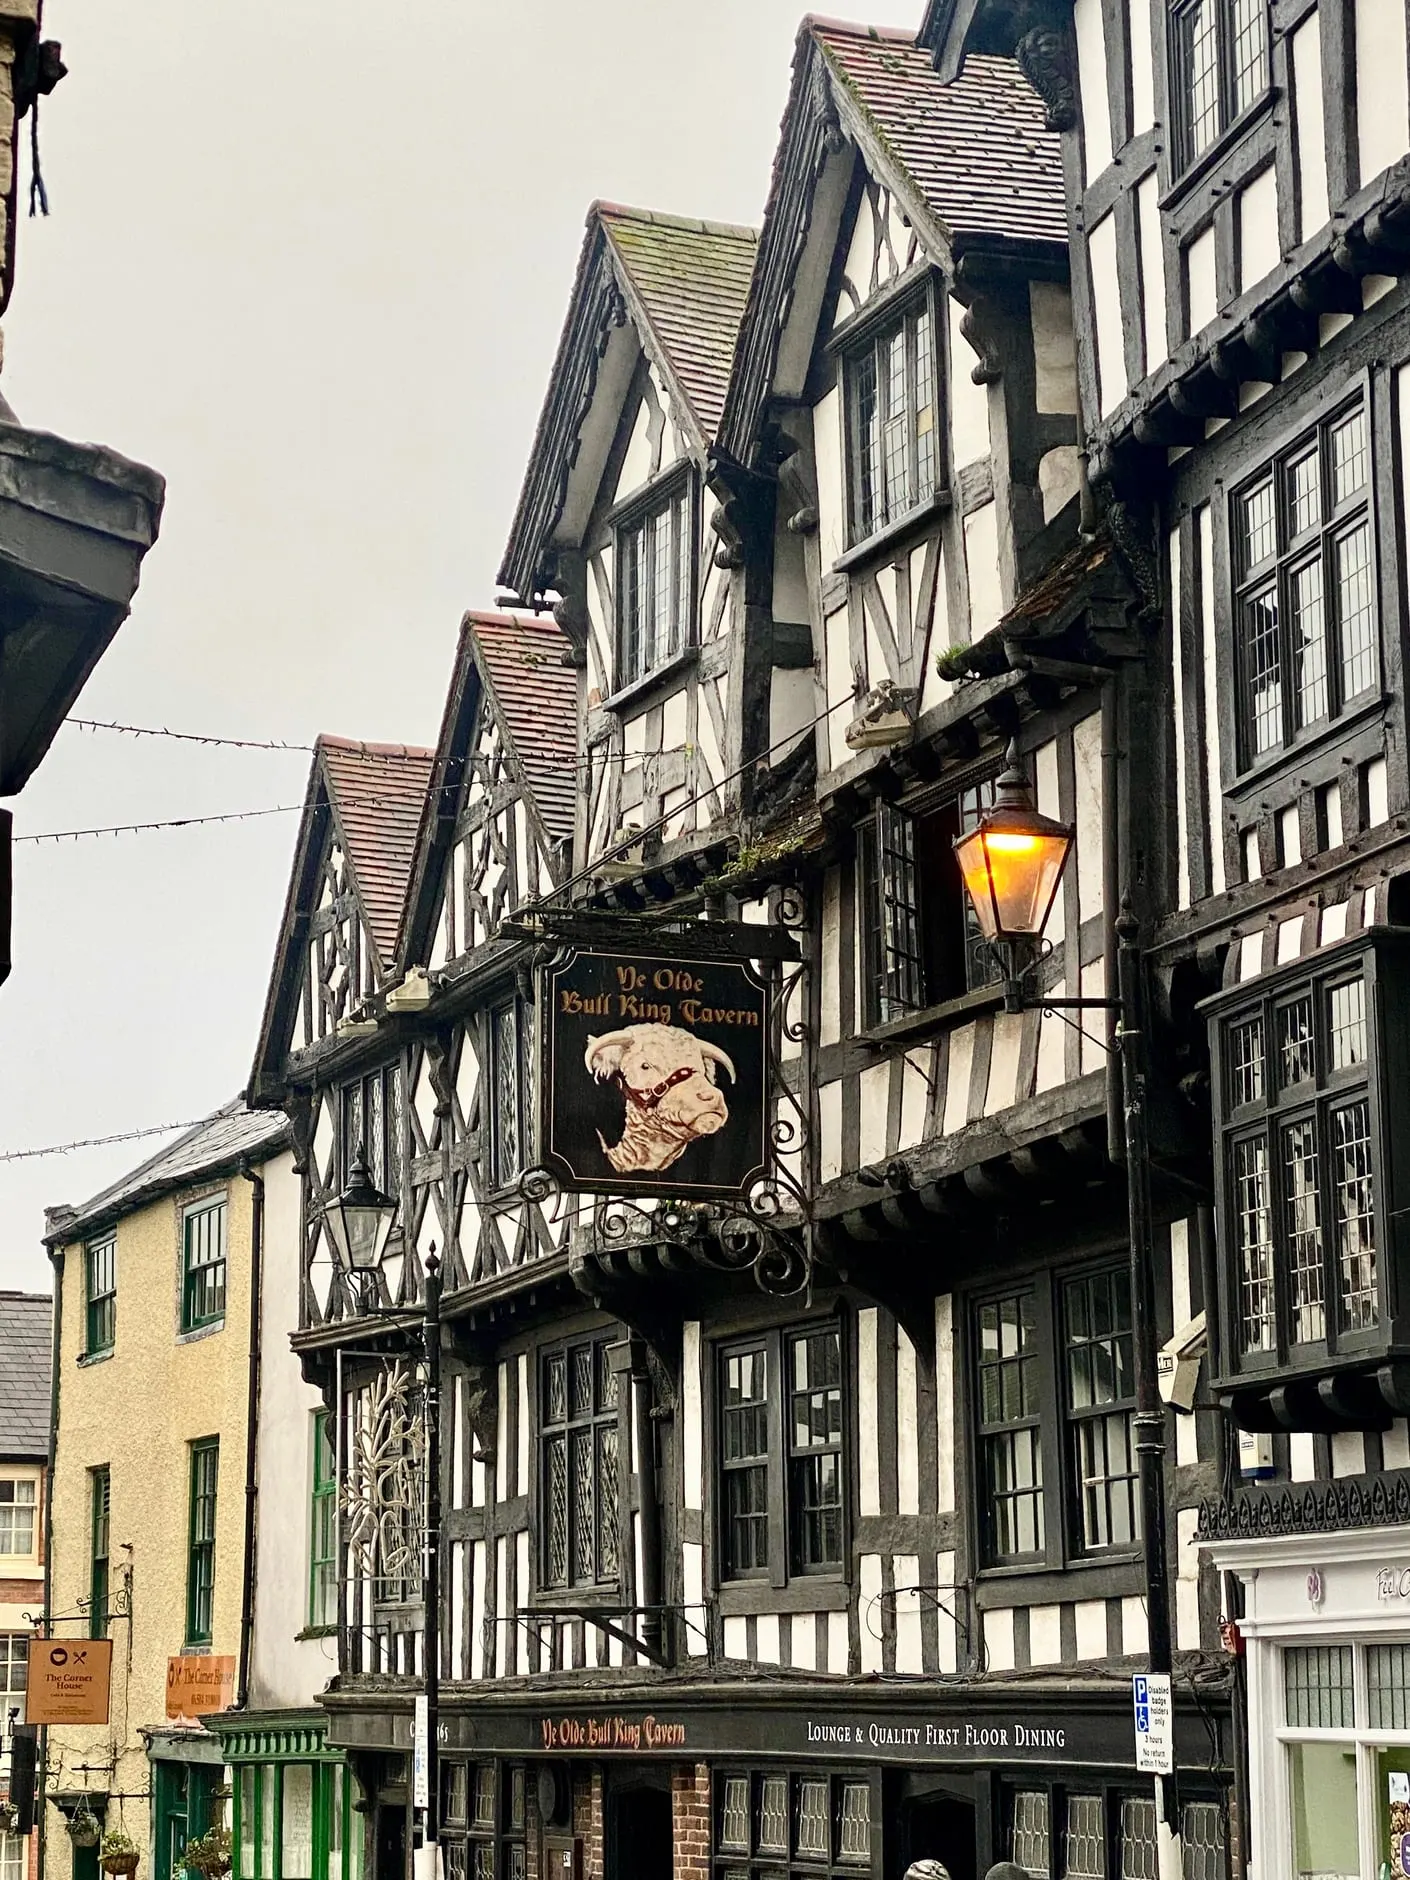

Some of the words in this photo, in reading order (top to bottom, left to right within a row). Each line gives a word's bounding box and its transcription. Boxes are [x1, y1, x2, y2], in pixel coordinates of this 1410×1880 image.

[616, 966, 647, 991] Ye
[653, 968, 704, 992] Olde
[560, 990, 612, 1016] Bull
[618, 994, 671, 1024] Ring
[678, 999, 759, 1026] Tavern
[46, 1674, 62, 1682] The
[63, 1674, 93, 1682] Corner
[56, 1682, 83, 1690] House
[1148, 1686, 1169, 1694] Disabled
[1138, 1680, 1146, 1702] P
[1152, 1696, 1166, 1706] badge
[1151, 1707, 1168, 1715] holders
[1155, 1717, 1165, 1727] only
[542, 1718, 557, 1749] Ye
[560, 1718, 585, 1746] Olde
[586, 1717, 611, 1746] Bull
[614, 1716, 640, 1749] Ring
[643, 1715, 685, 1748] Tavern
[807, 1721, 851, 1743] LOUNGE
[855, 1727, 863, 1743] &
[869, 1723, 920, 1746] QUALITY
[925, 1724, 960, 1745] FIRST
[965, 1724, 1008, 1746] FLOOR
[1014, 1725, 1065, 1747] DINING
[1149, 1735, 1162, 1744] hours
[1143, 1748, 1150, 1756] No
[1151, 1749, 1165, 1757] return
[1140, 1759, 1154, 1767] within
[1158, 1760, 1169, 1768] hour
